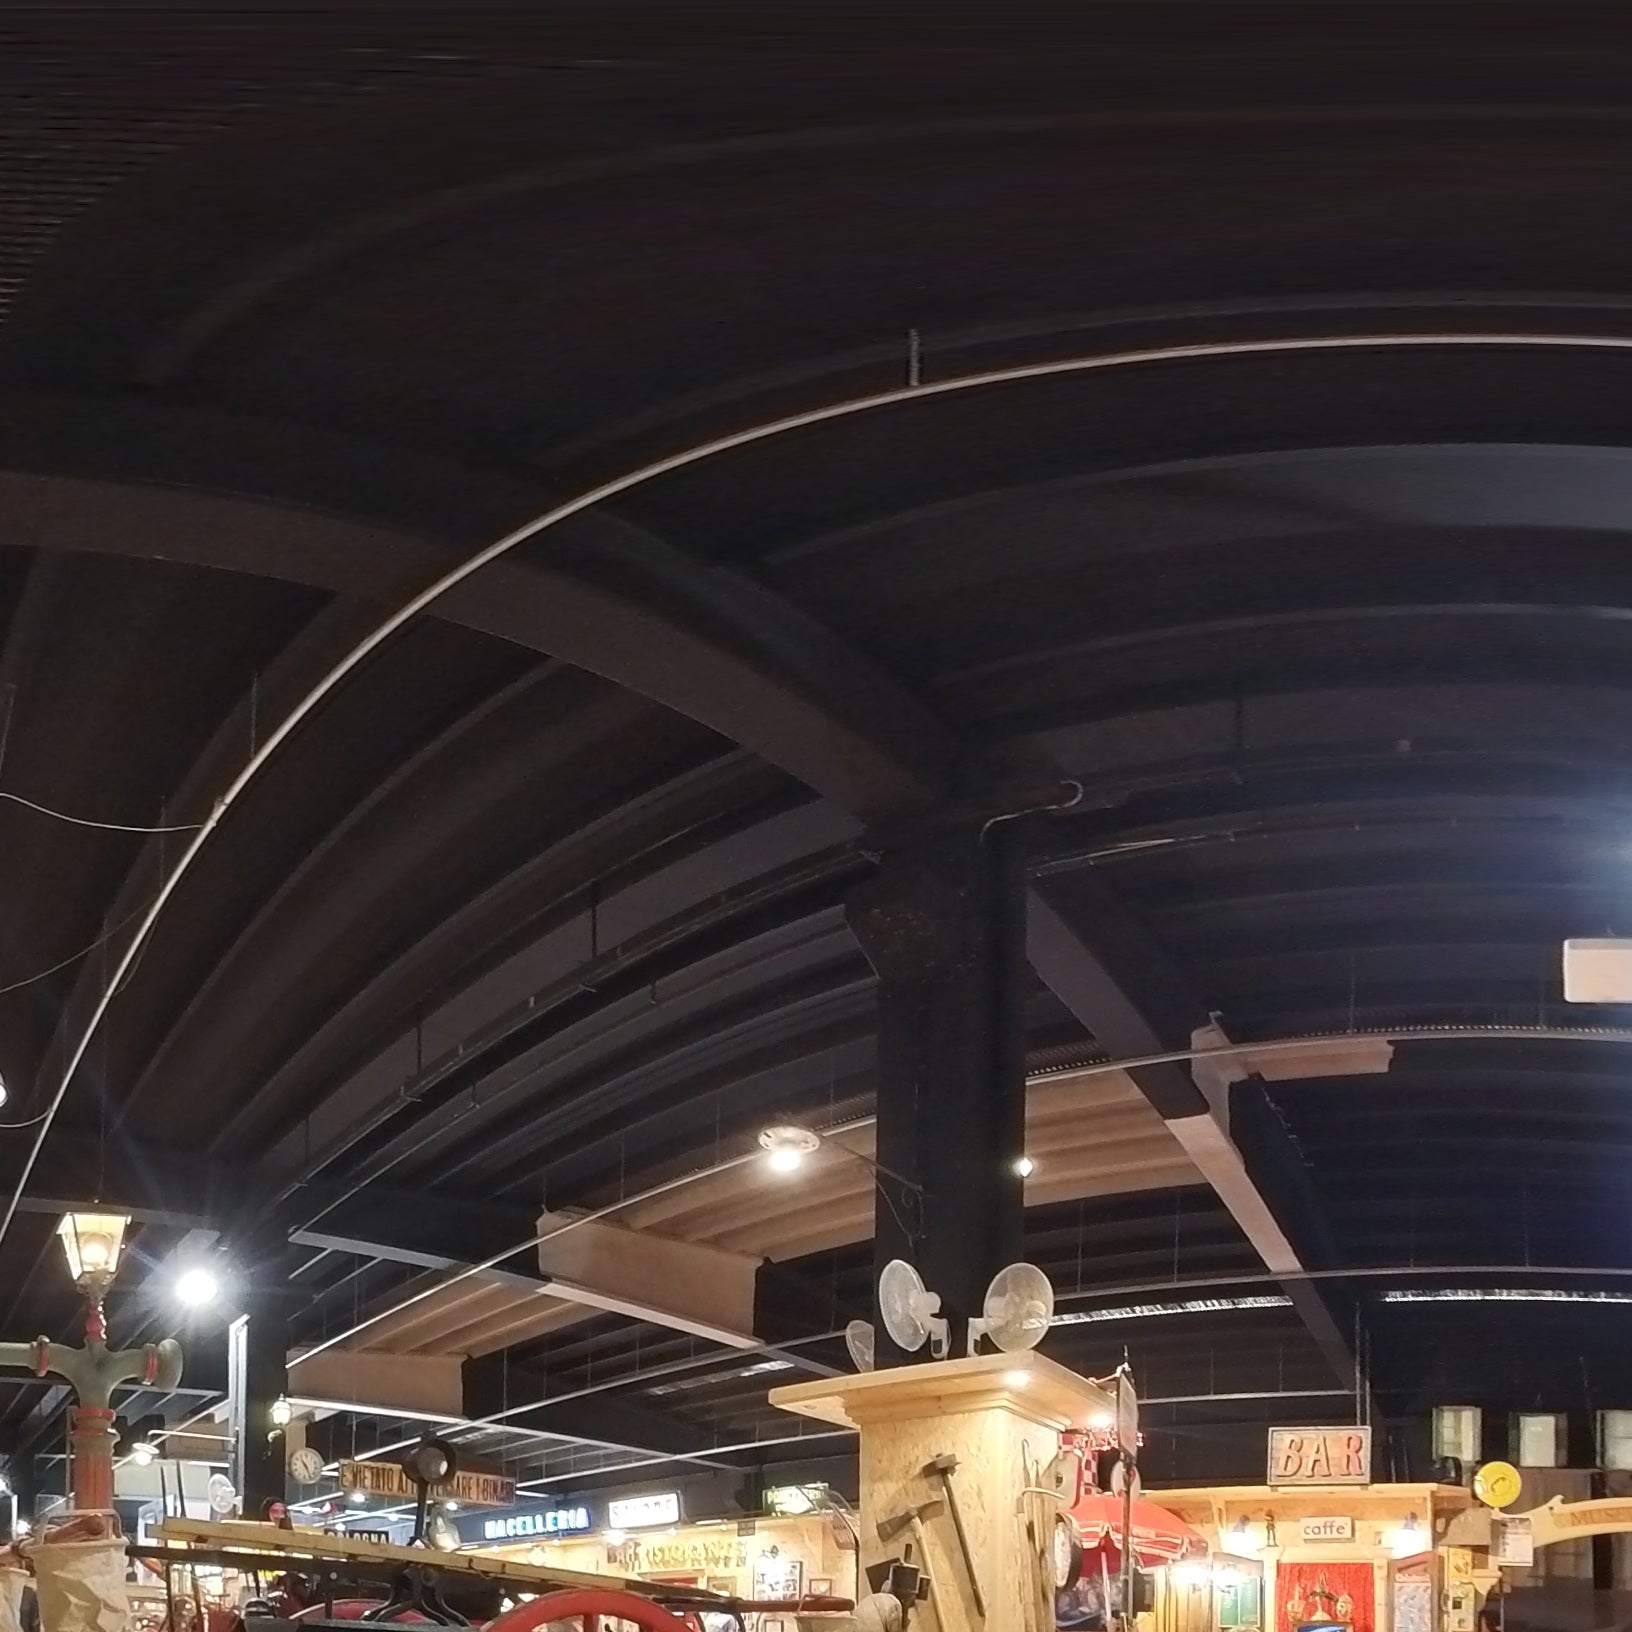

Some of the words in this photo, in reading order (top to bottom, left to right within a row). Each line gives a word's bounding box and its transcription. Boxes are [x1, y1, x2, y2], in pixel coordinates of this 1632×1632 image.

[1276, 1432, 1365, 1478] BAR
[352, 1463, 393, 1491] VIETATO
[484, 1507, 589, 1539] MACELLERIA
